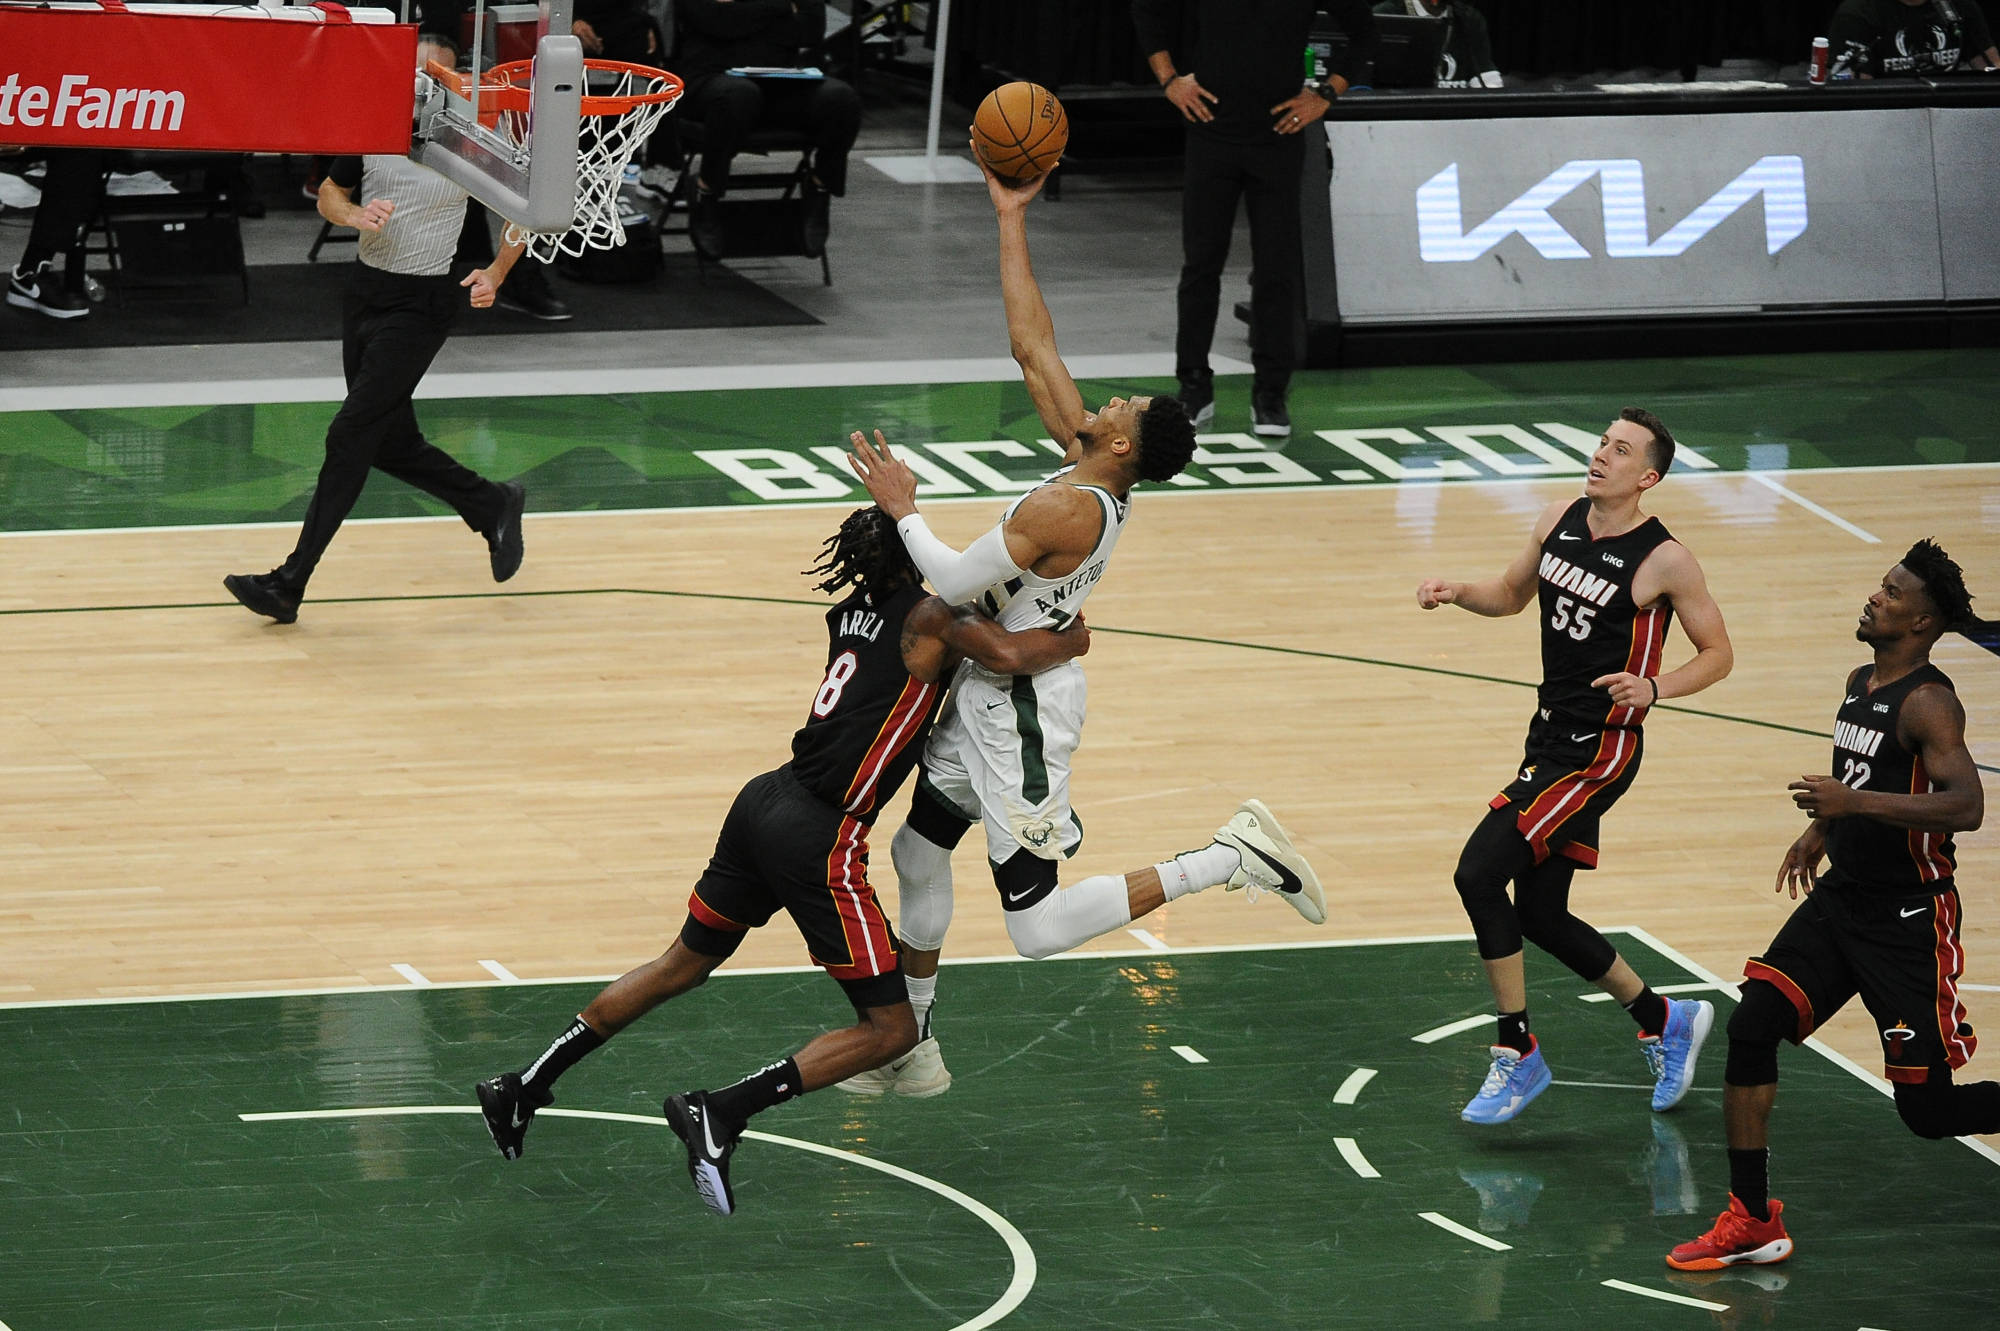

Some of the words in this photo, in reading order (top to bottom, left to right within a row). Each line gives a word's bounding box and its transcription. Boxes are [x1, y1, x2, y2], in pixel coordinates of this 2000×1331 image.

[1416, 155, 1808, 262] KIA
[1539, 552, 1620, 607] MIAMI
[839, 610, 885, 642] ARIZA
[1552, 595, 1597, 641] 55
[813, 650, 858, 719] 8
[1834, 720, 1885, 757] MIAMI
[1841, 758, 1872, 791] 22
